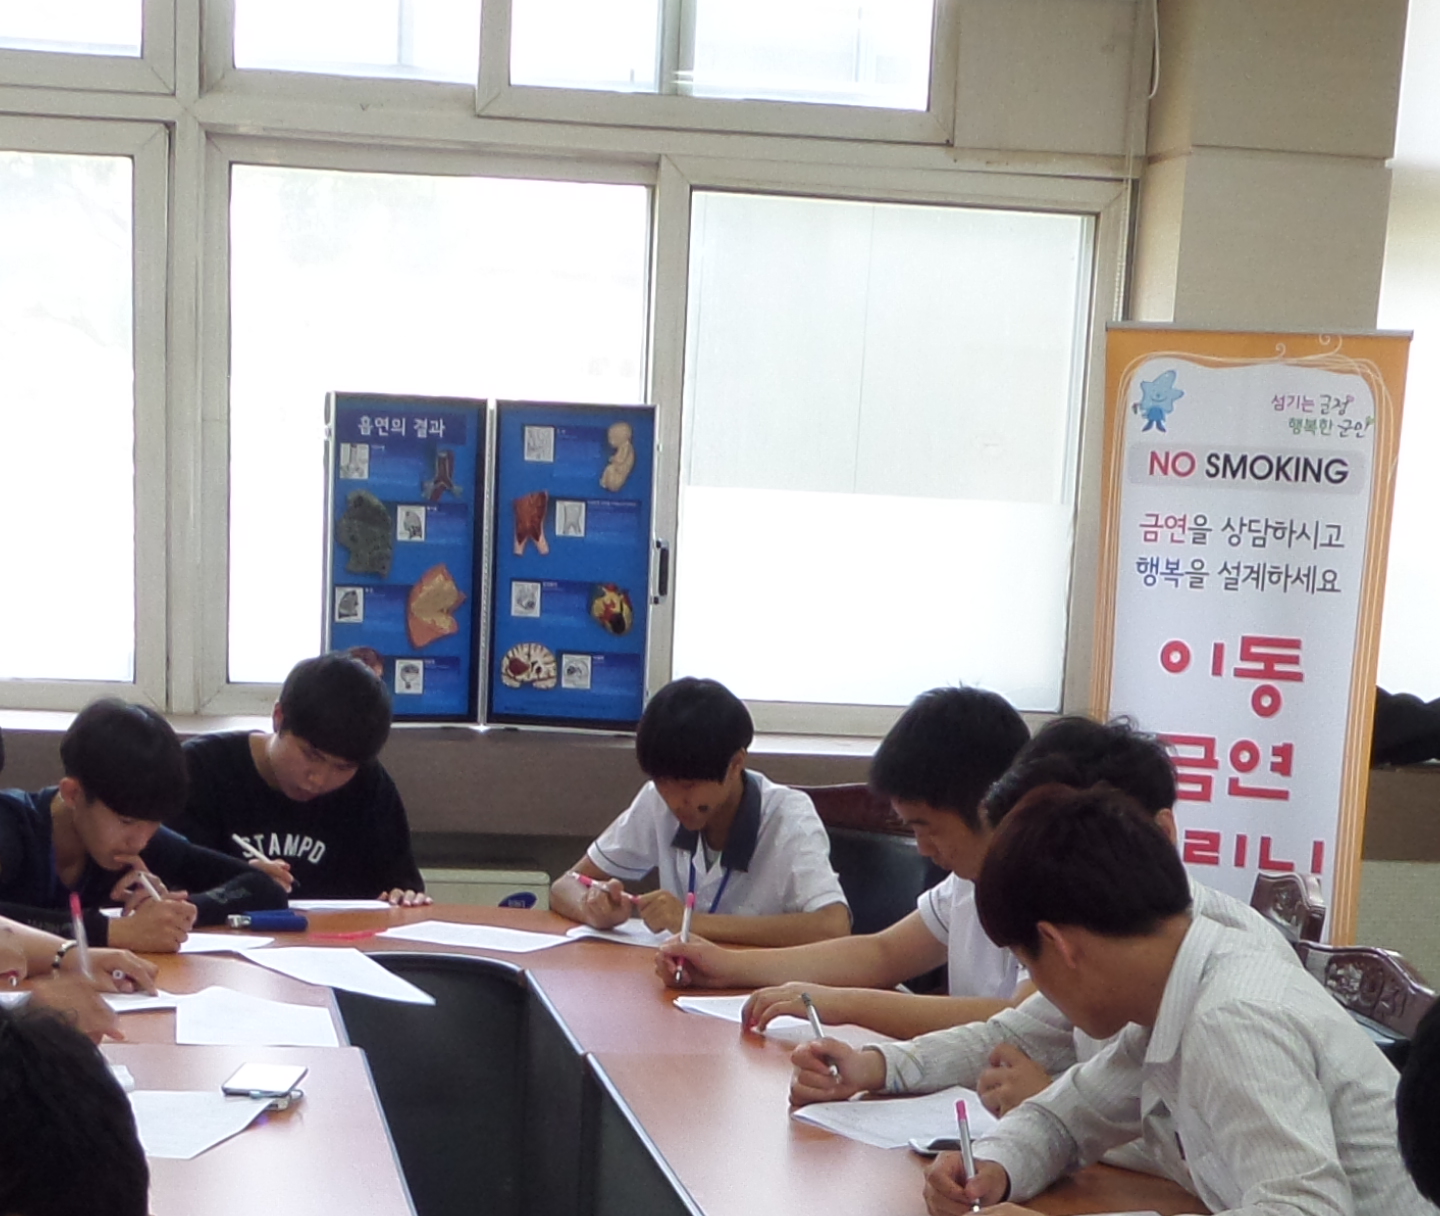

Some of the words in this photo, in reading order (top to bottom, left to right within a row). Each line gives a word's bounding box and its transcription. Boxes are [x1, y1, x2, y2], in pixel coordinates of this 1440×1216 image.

[1271, 394, 1315, 413] 섬기는
[357, 414, 407, 437] 흡연의
[413, 417, 447, 439] 결과
[1288, 417, 1333, 436] 행복한
[1148, 450, 1197, 478] NO
[1204, 452, 1350, 485] SMOKING
[1138, 512, 1213, 546] 금연을
[1220, 515, 1346, 550] 상담하시고
[1135, 555, 1211, 591] 행복을
[1216, 560, 1342, 596] 설계하세요
[1159, 634, 1305, 719] 이동
[1156, 733, 1295, 803] 금연
[241, 832, 327, 864] STAMPD
